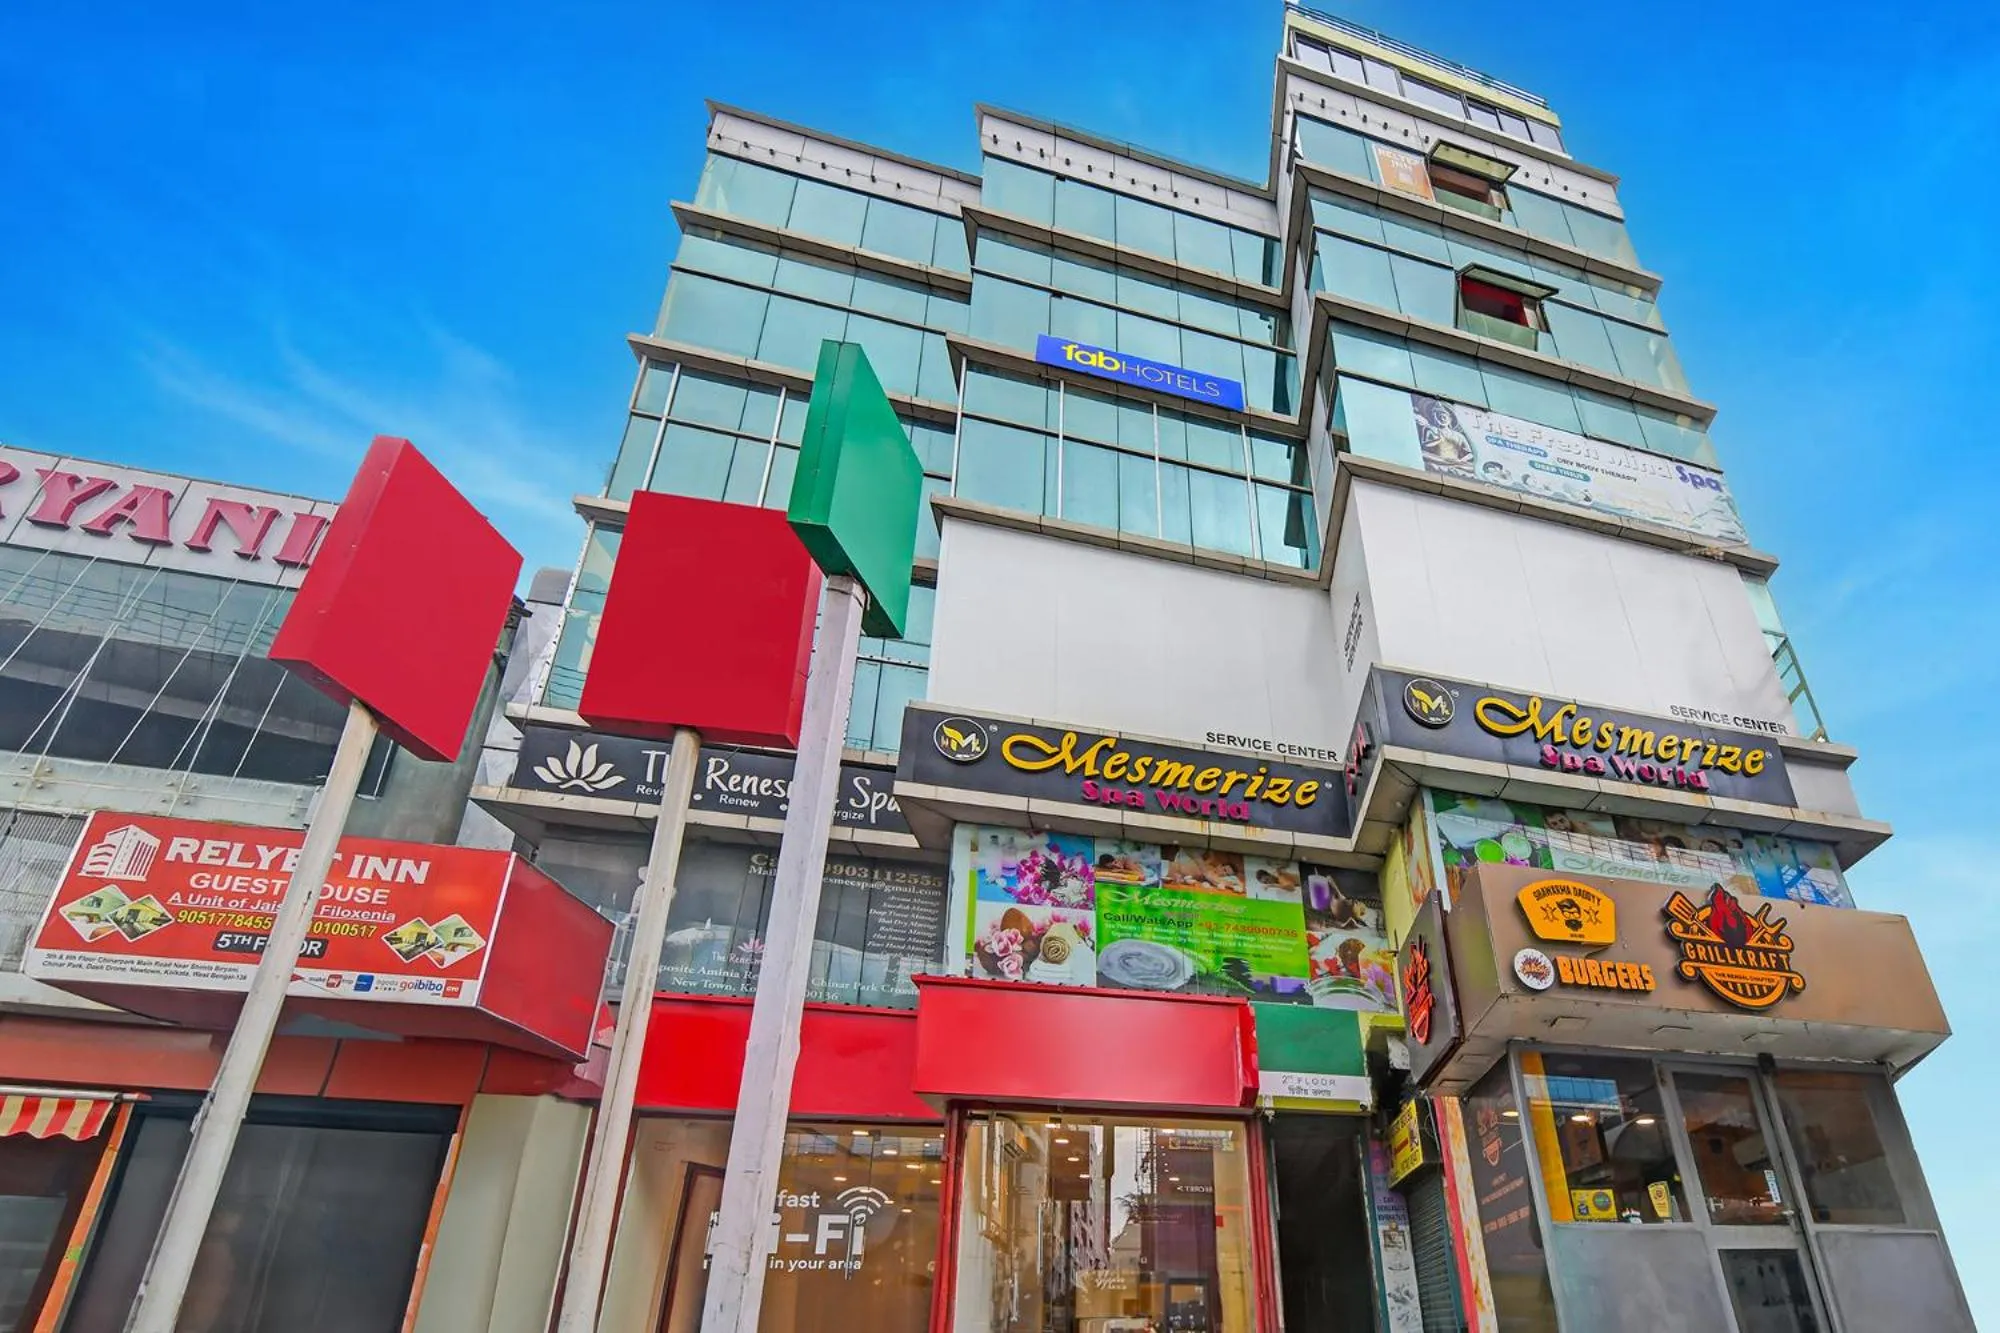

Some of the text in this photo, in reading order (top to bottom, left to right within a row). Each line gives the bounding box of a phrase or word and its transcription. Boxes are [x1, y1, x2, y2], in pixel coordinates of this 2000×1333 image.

[1676, 464, 1723, 493] Spa
[0, 461, 331, 568] YANI
[1474, 694, 1766, 777] Mesmerize
[1670, 705, 1789, 736] SERVICE CENTER
[1206, 731, 1338, 762] SERVICE CENTER
[1001, 731, 1321, 807] Mesmerize
[1541, 743, 1710, 791] Spa World
[719, 794, 760, 809] Renew
[1081, 780, 1250, 821] Spa World
[346, 854, 430, 884] INN
[189, 872, 391, 905] GUEST OUSE
[167, 892, 181, 905] A
[188, 893, 223, 907] Unit
[229, 896, 248, 909] of
[320, 905, 397, 922] Filoxenia
[177, 909, 273, 930] 9051778455
[1684, 942, 1790, 972] GRILLKRAFT
[400, 979, 443, 993] goibibo
[672, 976, 698, 988] New
[1554, 954, 1656, 991] BURGERS
[1297, 1076, 1336, 1087] FLOOR
[777, 1188, 821, 1208] fast
[769, 1256, 784, 1270] in
[789, 1259, 824, 1273] your
